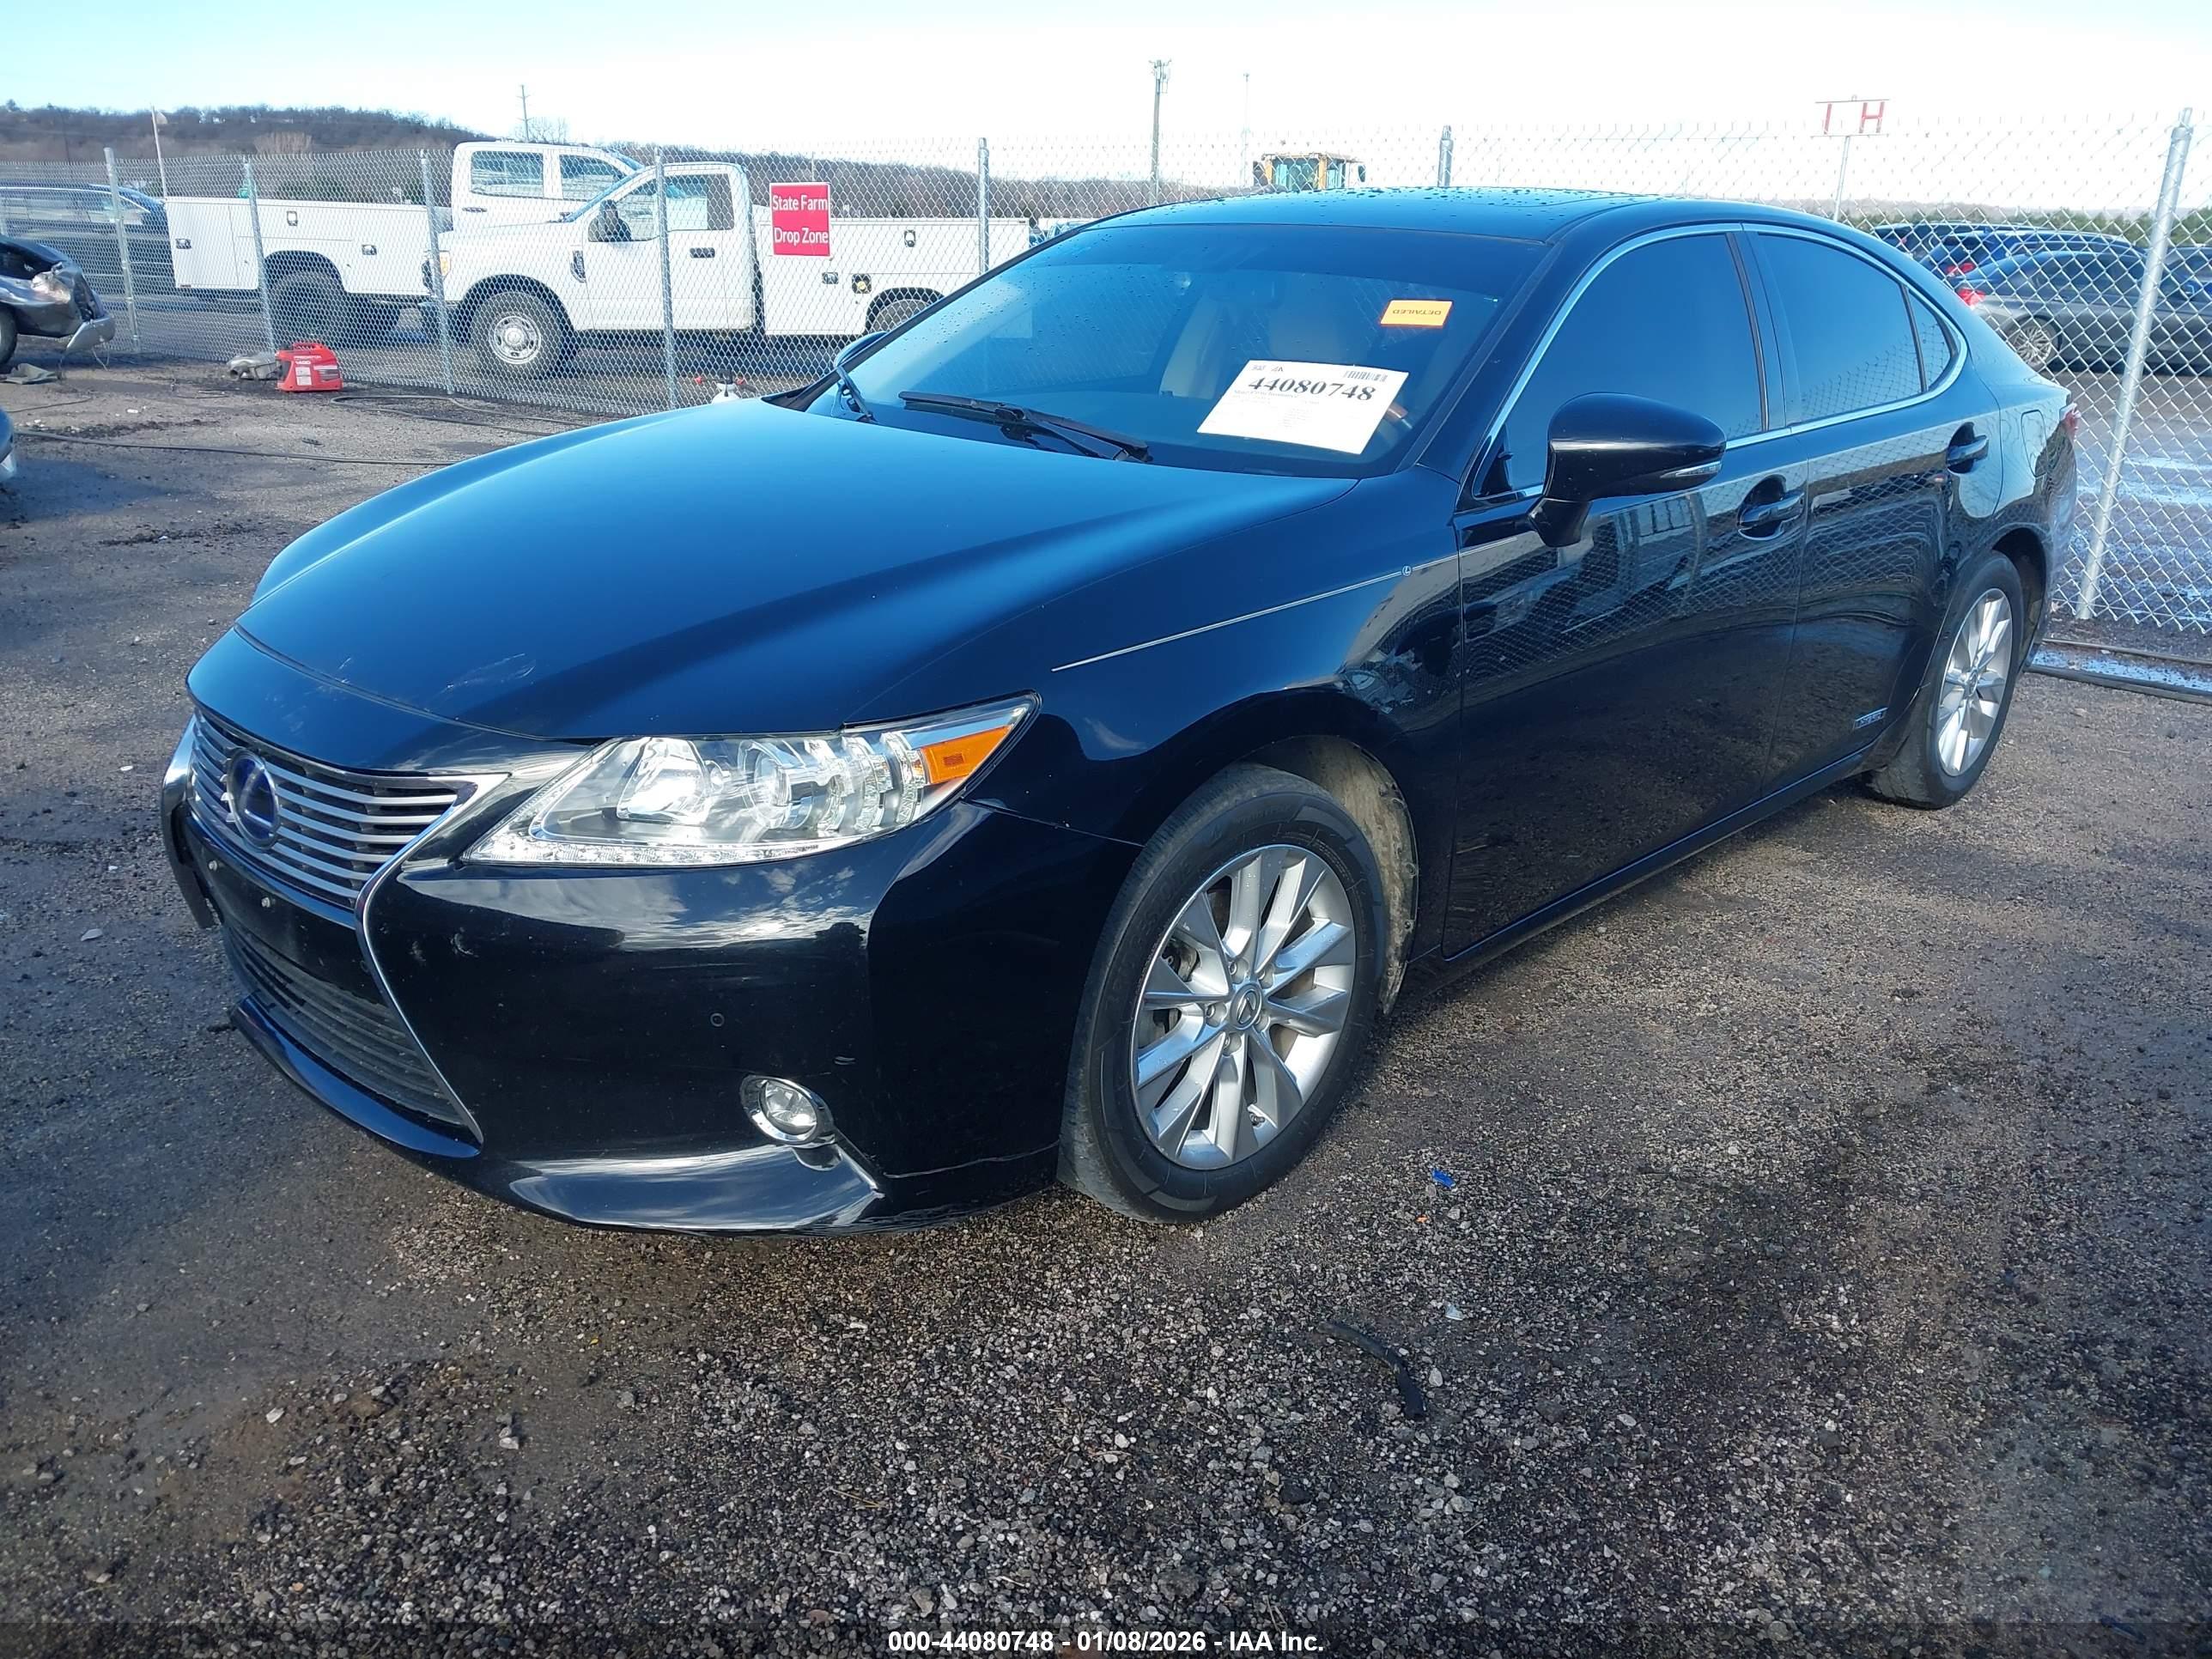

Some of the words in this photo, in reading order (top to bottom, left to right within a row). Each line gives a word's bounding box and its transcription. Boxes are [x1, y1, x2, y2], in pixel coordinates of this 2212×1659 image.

[772, 194, 799, 210] State
[800, 194, 828, 210] Farm
[774, 227, 799, 246] Drop
[801, 227, 829, 244] Zone
[1248, 376, 1376, 401] 44080748
